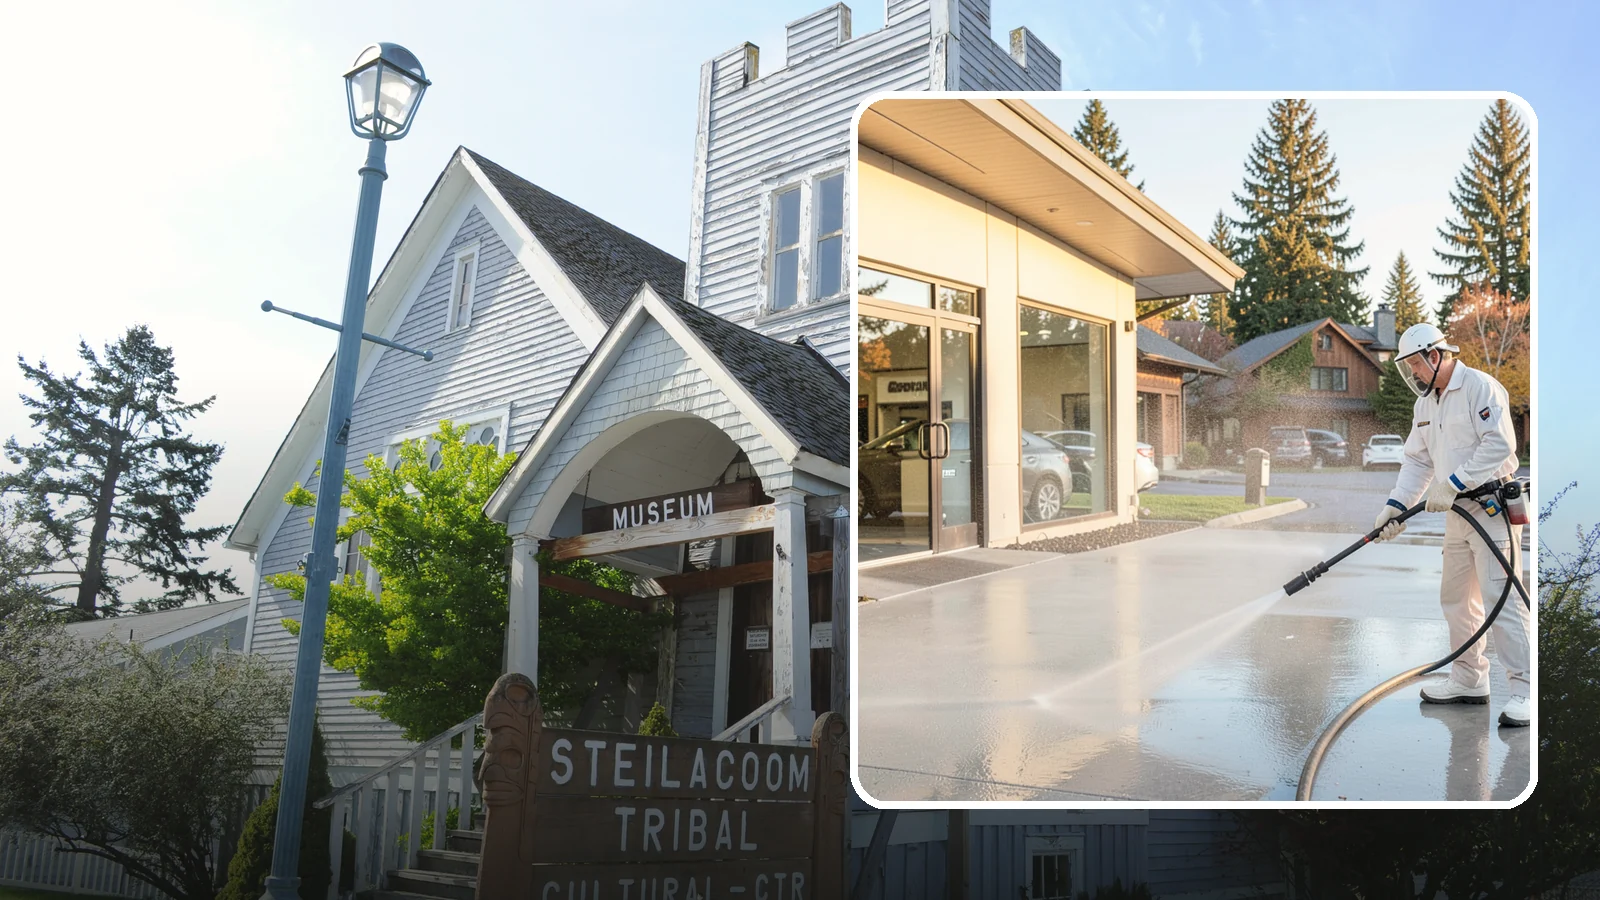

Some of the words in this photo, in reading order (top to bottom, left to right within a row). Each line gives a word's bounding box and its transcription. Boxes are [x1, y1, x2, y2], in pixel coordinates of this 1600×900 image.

[612, 492, 713, 530] MUSEUM
[551, 739, 809, 792] STEILACOOM
[615, 806, 757, 851] TRIBAL
